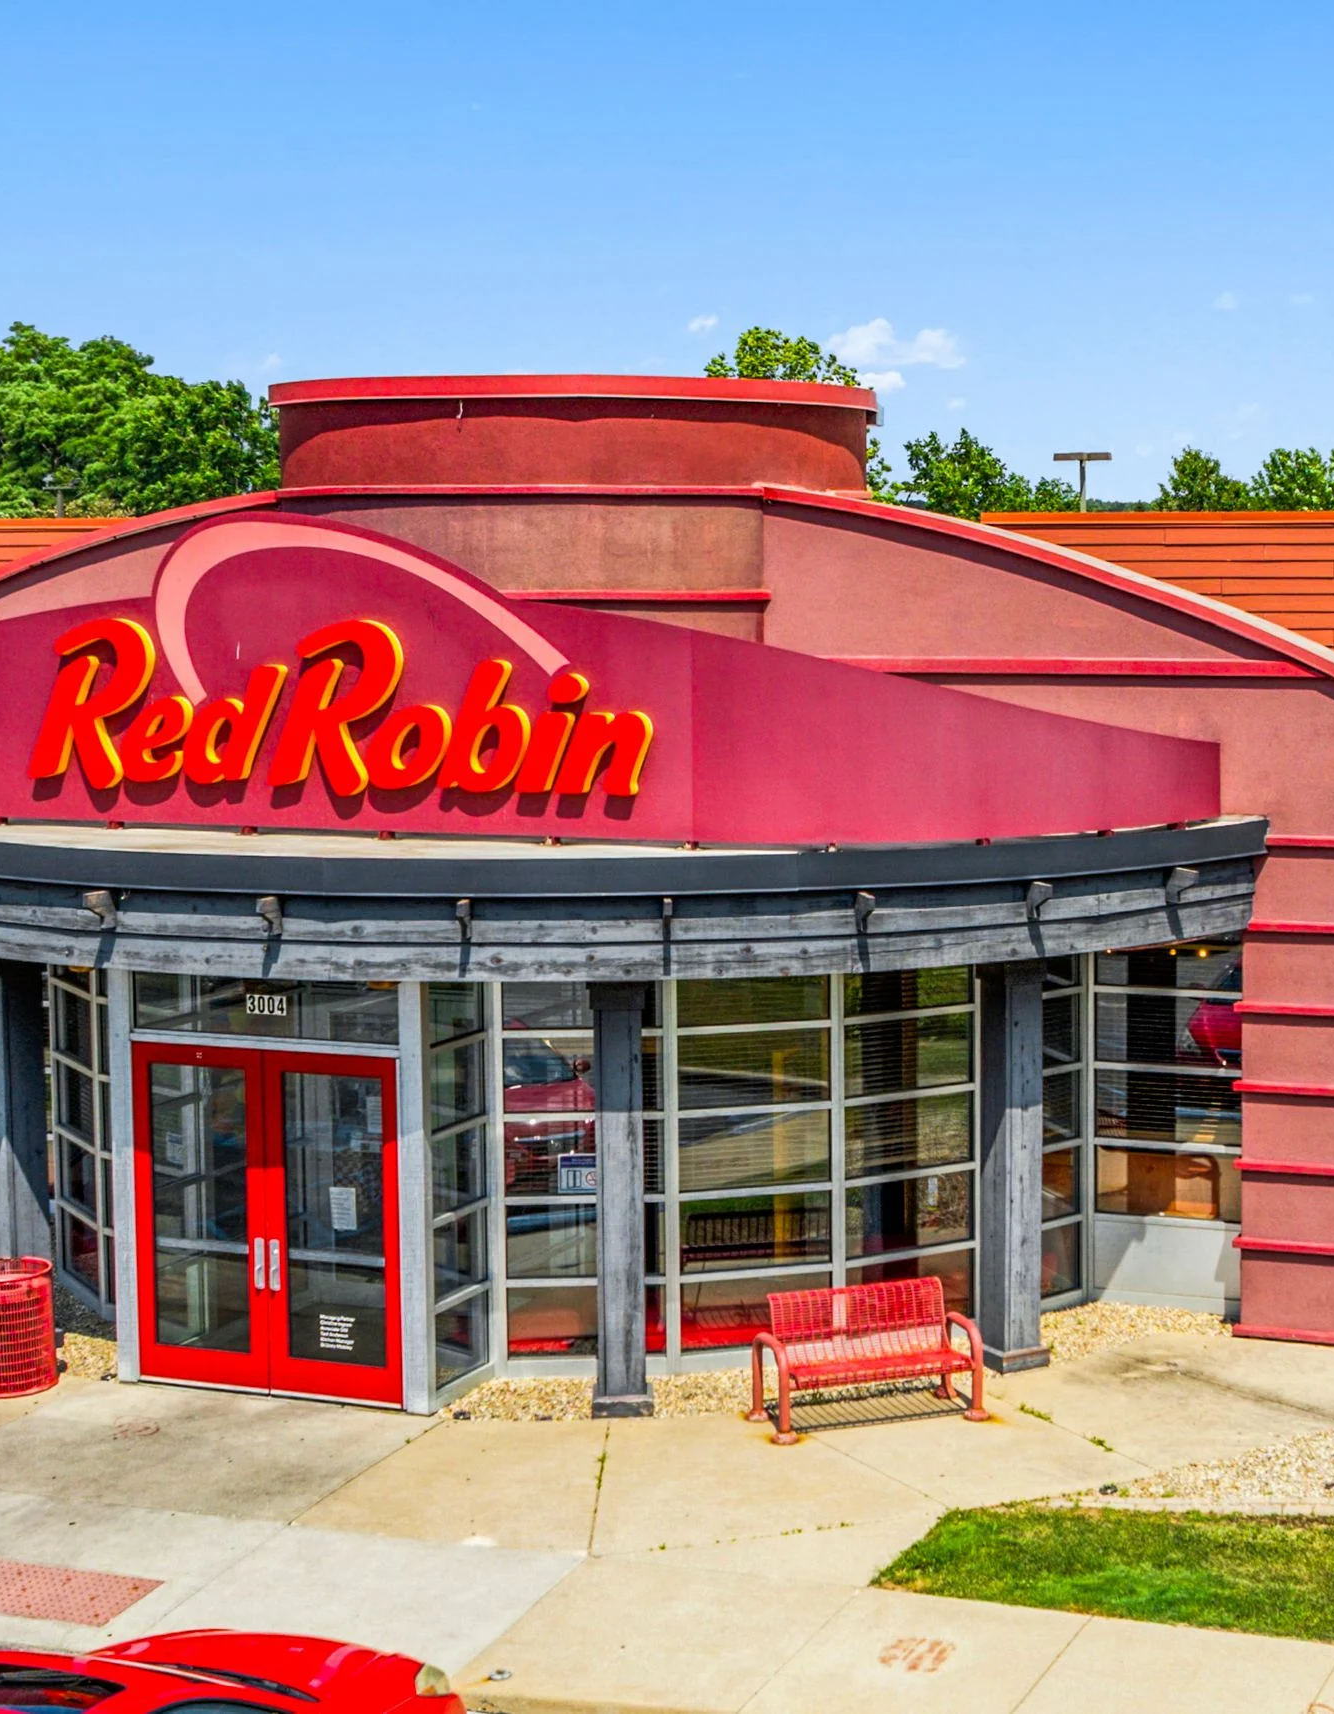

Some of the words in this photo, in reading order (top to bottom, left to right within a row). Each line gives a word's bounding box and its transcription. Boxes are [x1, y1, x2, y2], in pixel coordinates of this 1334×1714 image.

[28, 618, 288, 790] Red
[270, 619, 655, 798] Robin
[248, 995, 285, 1014] 3004
